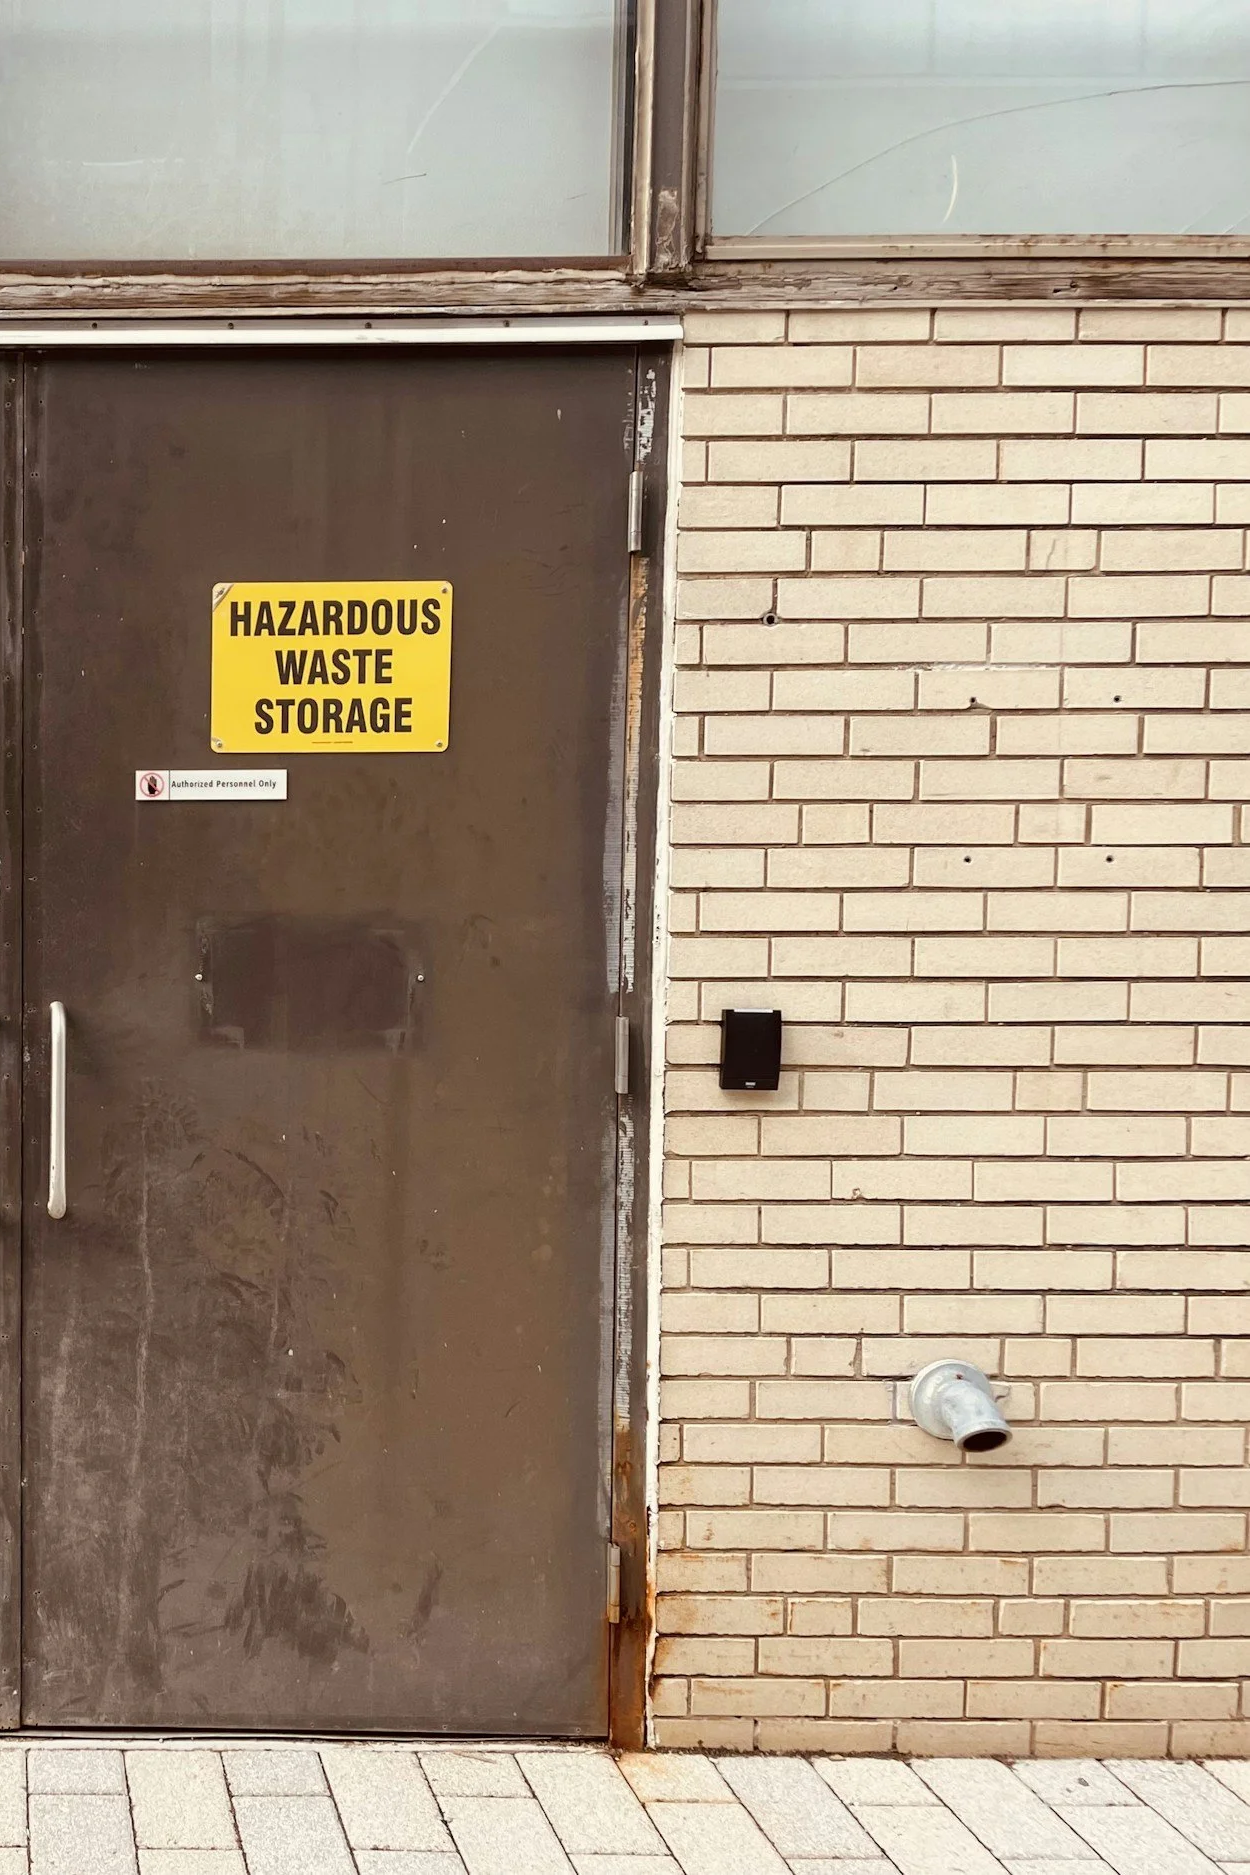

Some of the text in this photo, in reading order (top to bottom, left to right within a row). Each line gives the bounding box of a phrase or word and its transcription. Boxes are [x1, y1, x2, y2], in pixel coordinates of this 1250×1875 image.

[230, 598, 441, 636] HAZARDOUS
[275, 648, 393, 685] WASTE
[254, 697, 413, 735] STORAGE
[171, 779, 277, 790] Authorized Personnel Only
